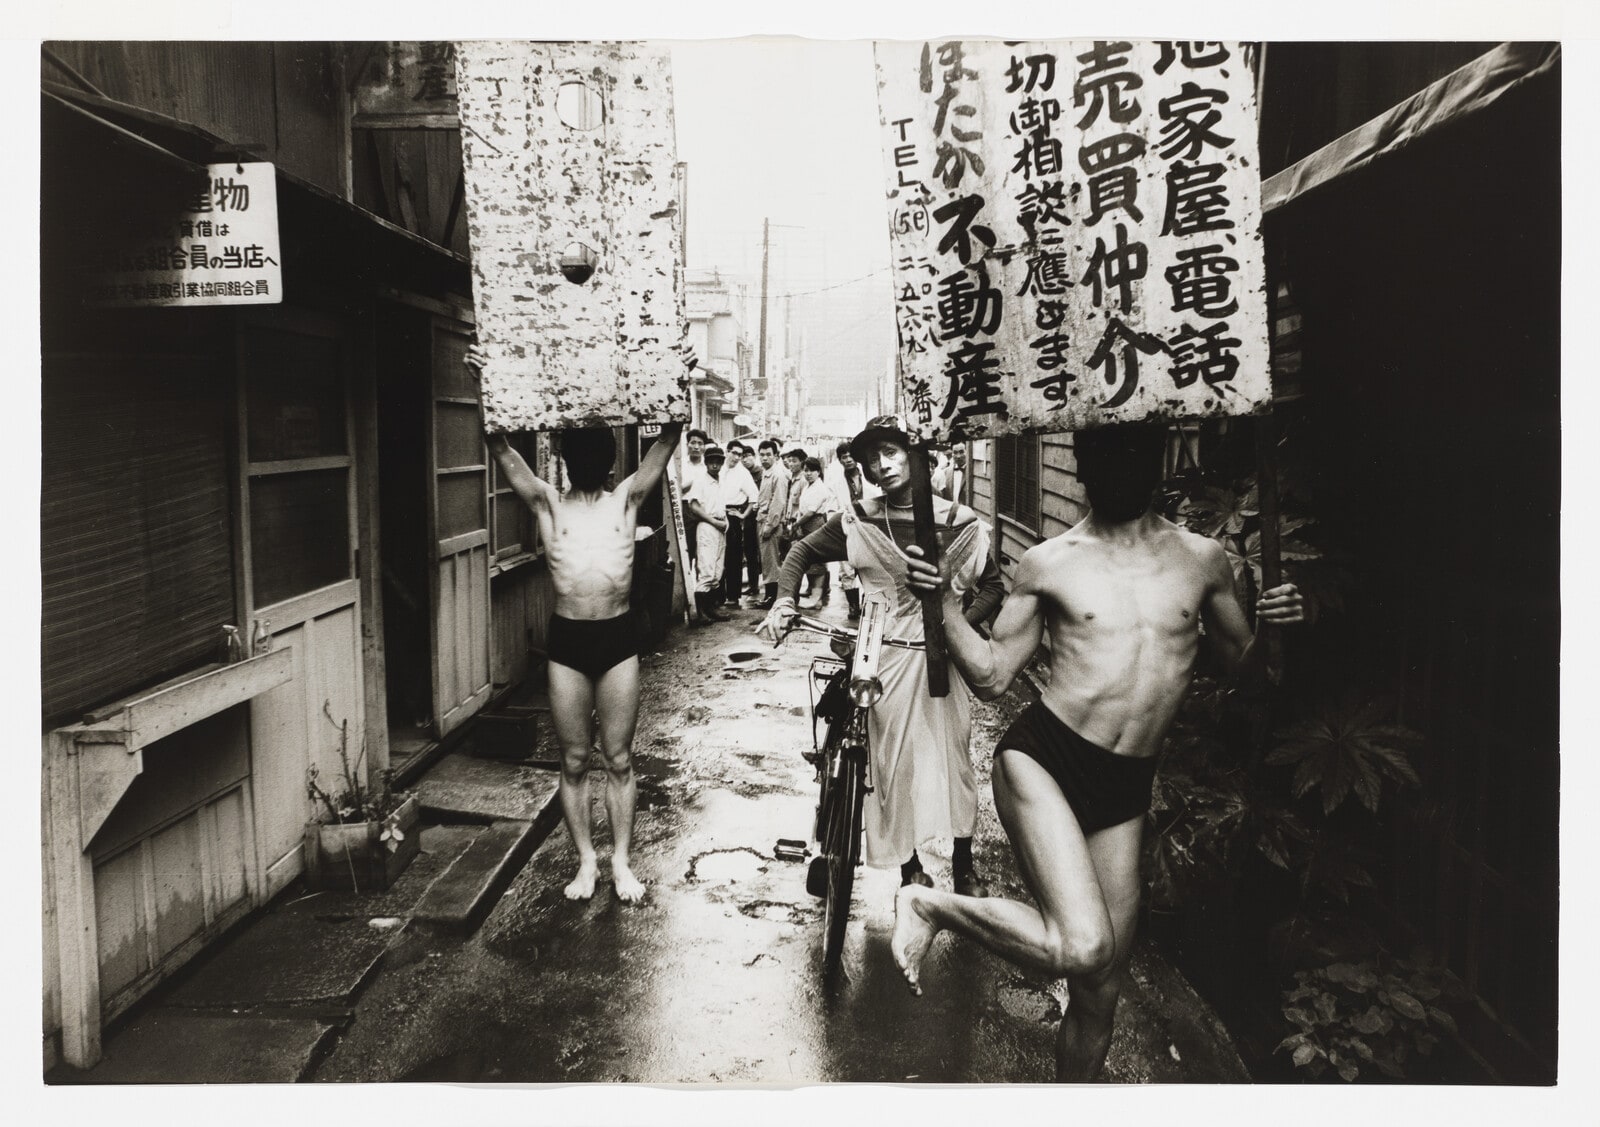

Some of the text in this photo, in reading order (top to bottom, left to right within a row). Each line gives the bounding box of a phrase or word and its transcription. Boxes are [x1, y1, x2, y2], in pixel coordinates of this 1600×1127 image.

[891, 118, 921, 187] TEL
[163, 220, 231, 239] 貸借は
[1073, 41, 1162, 408] 売買仲介
